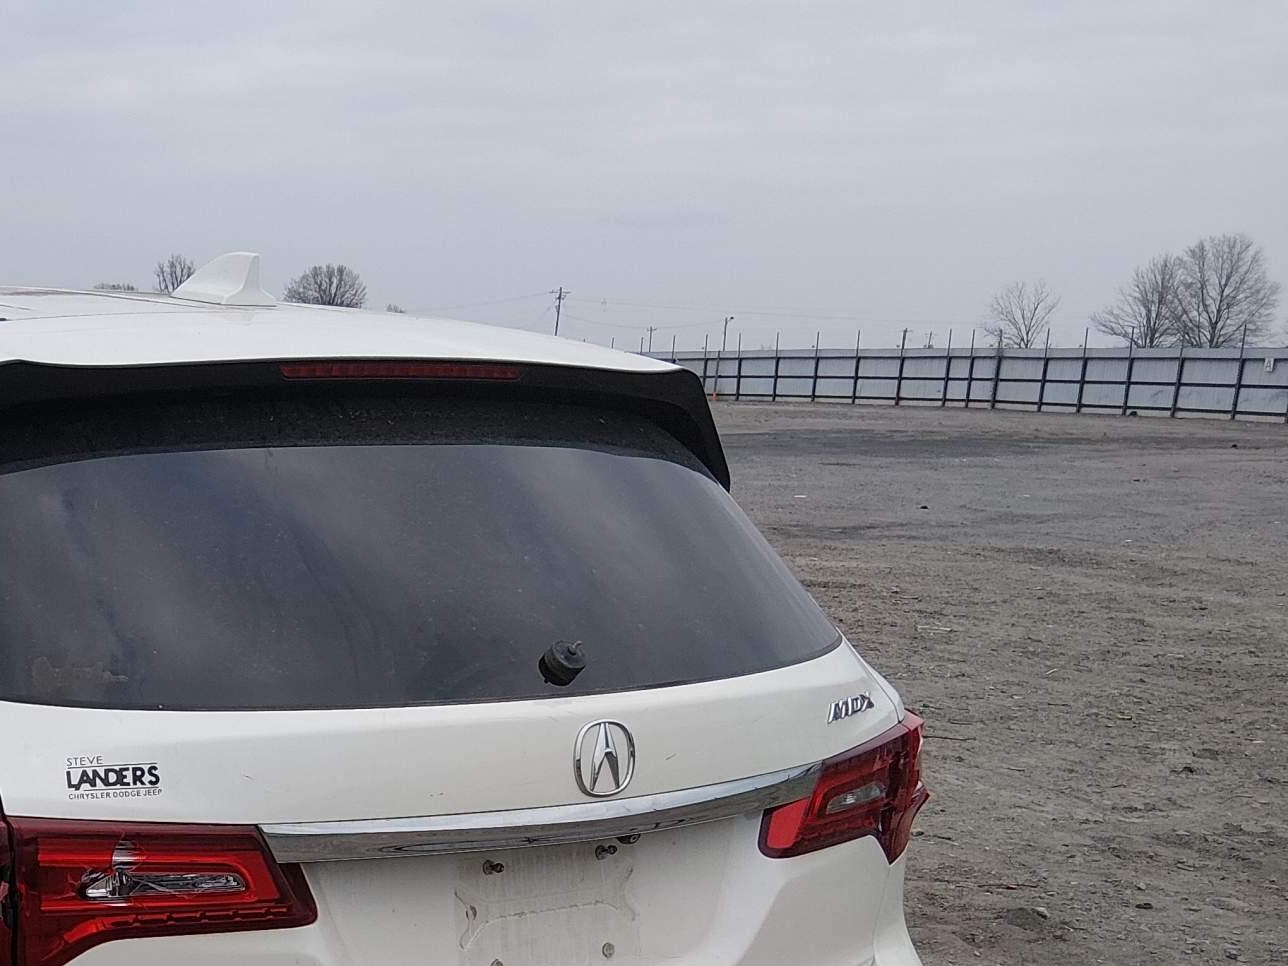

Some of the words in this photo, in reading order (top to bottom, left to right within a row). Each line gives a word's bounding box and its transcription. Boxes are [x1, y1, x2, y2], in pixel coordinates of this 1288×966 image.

[827, 692, 874, 724] MDX
[67, 756, 103, 766] STEVE
[66, 766, 160, 791] LANDERS
[68, 792, 111, 800] CHRYSLER
[112, 790, 141, 798] DODGE
